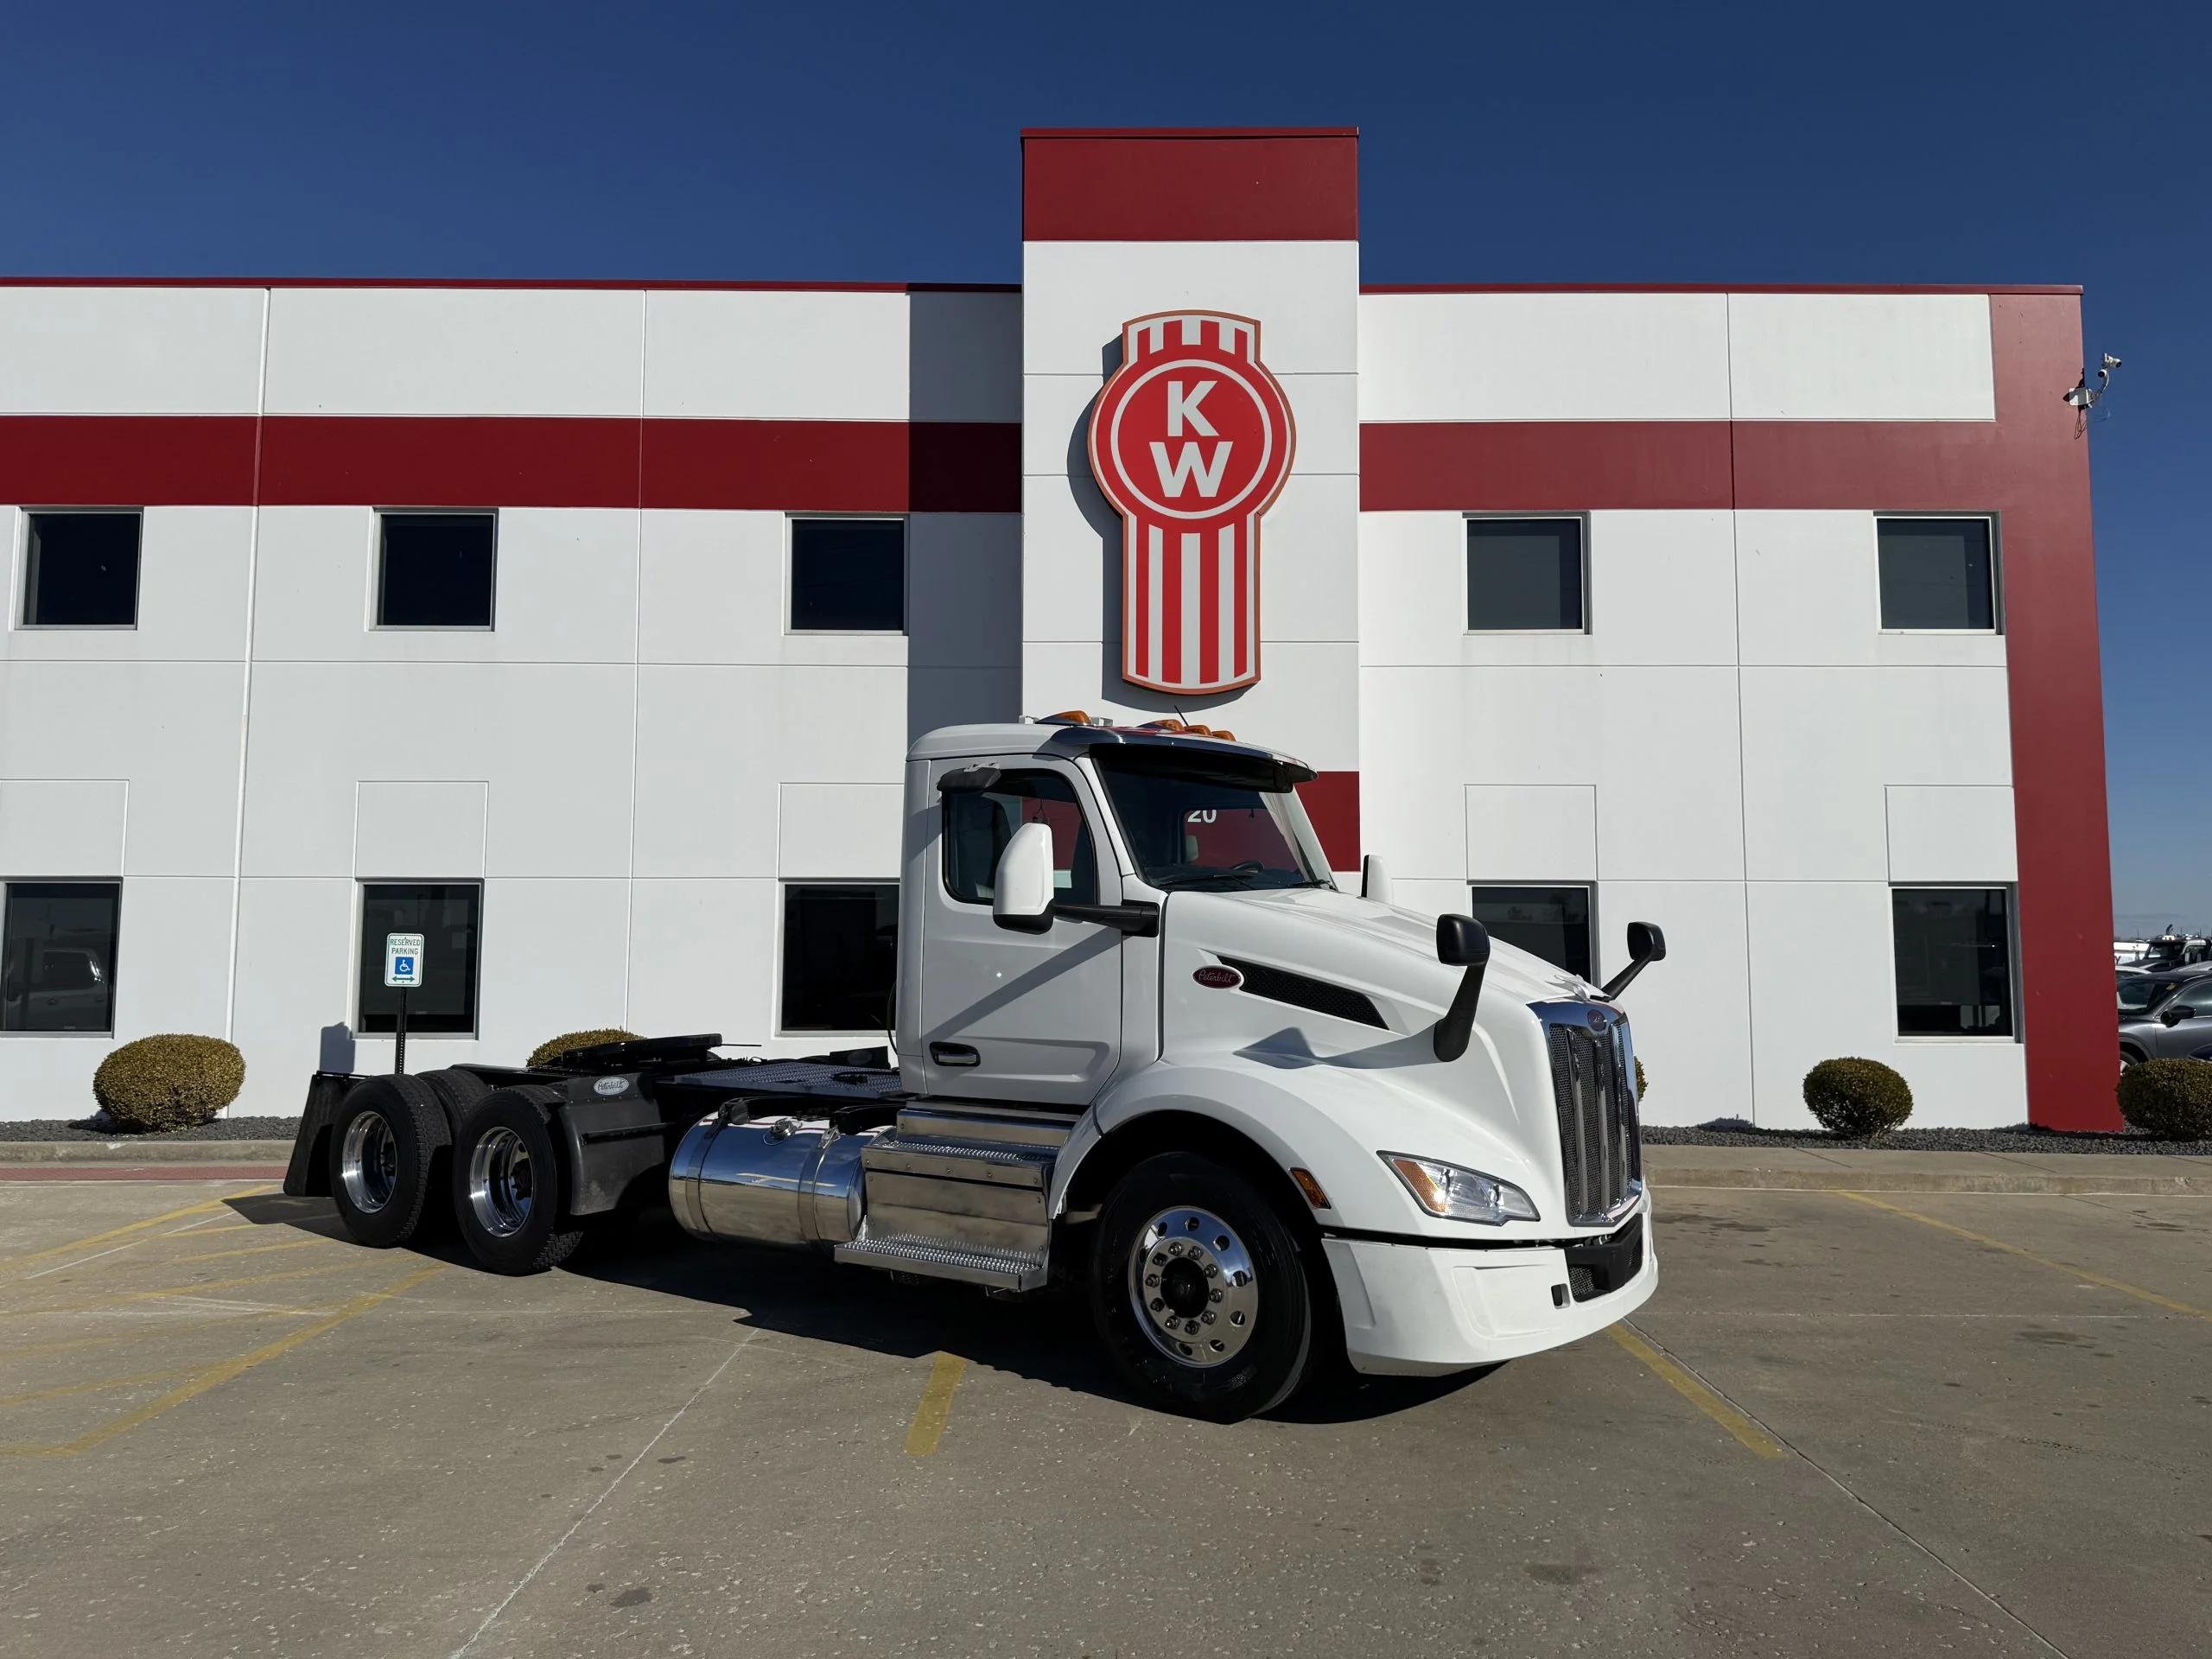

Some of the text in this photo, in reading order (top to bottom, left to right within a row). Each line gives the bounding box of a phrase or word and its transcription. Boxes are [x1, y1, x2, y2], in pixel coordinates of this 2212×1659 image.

[1167, 380, 1219, 437] K
[1148, 441, 1234, 498] W
[1198, 969, 1236, 983] Peterbilt
